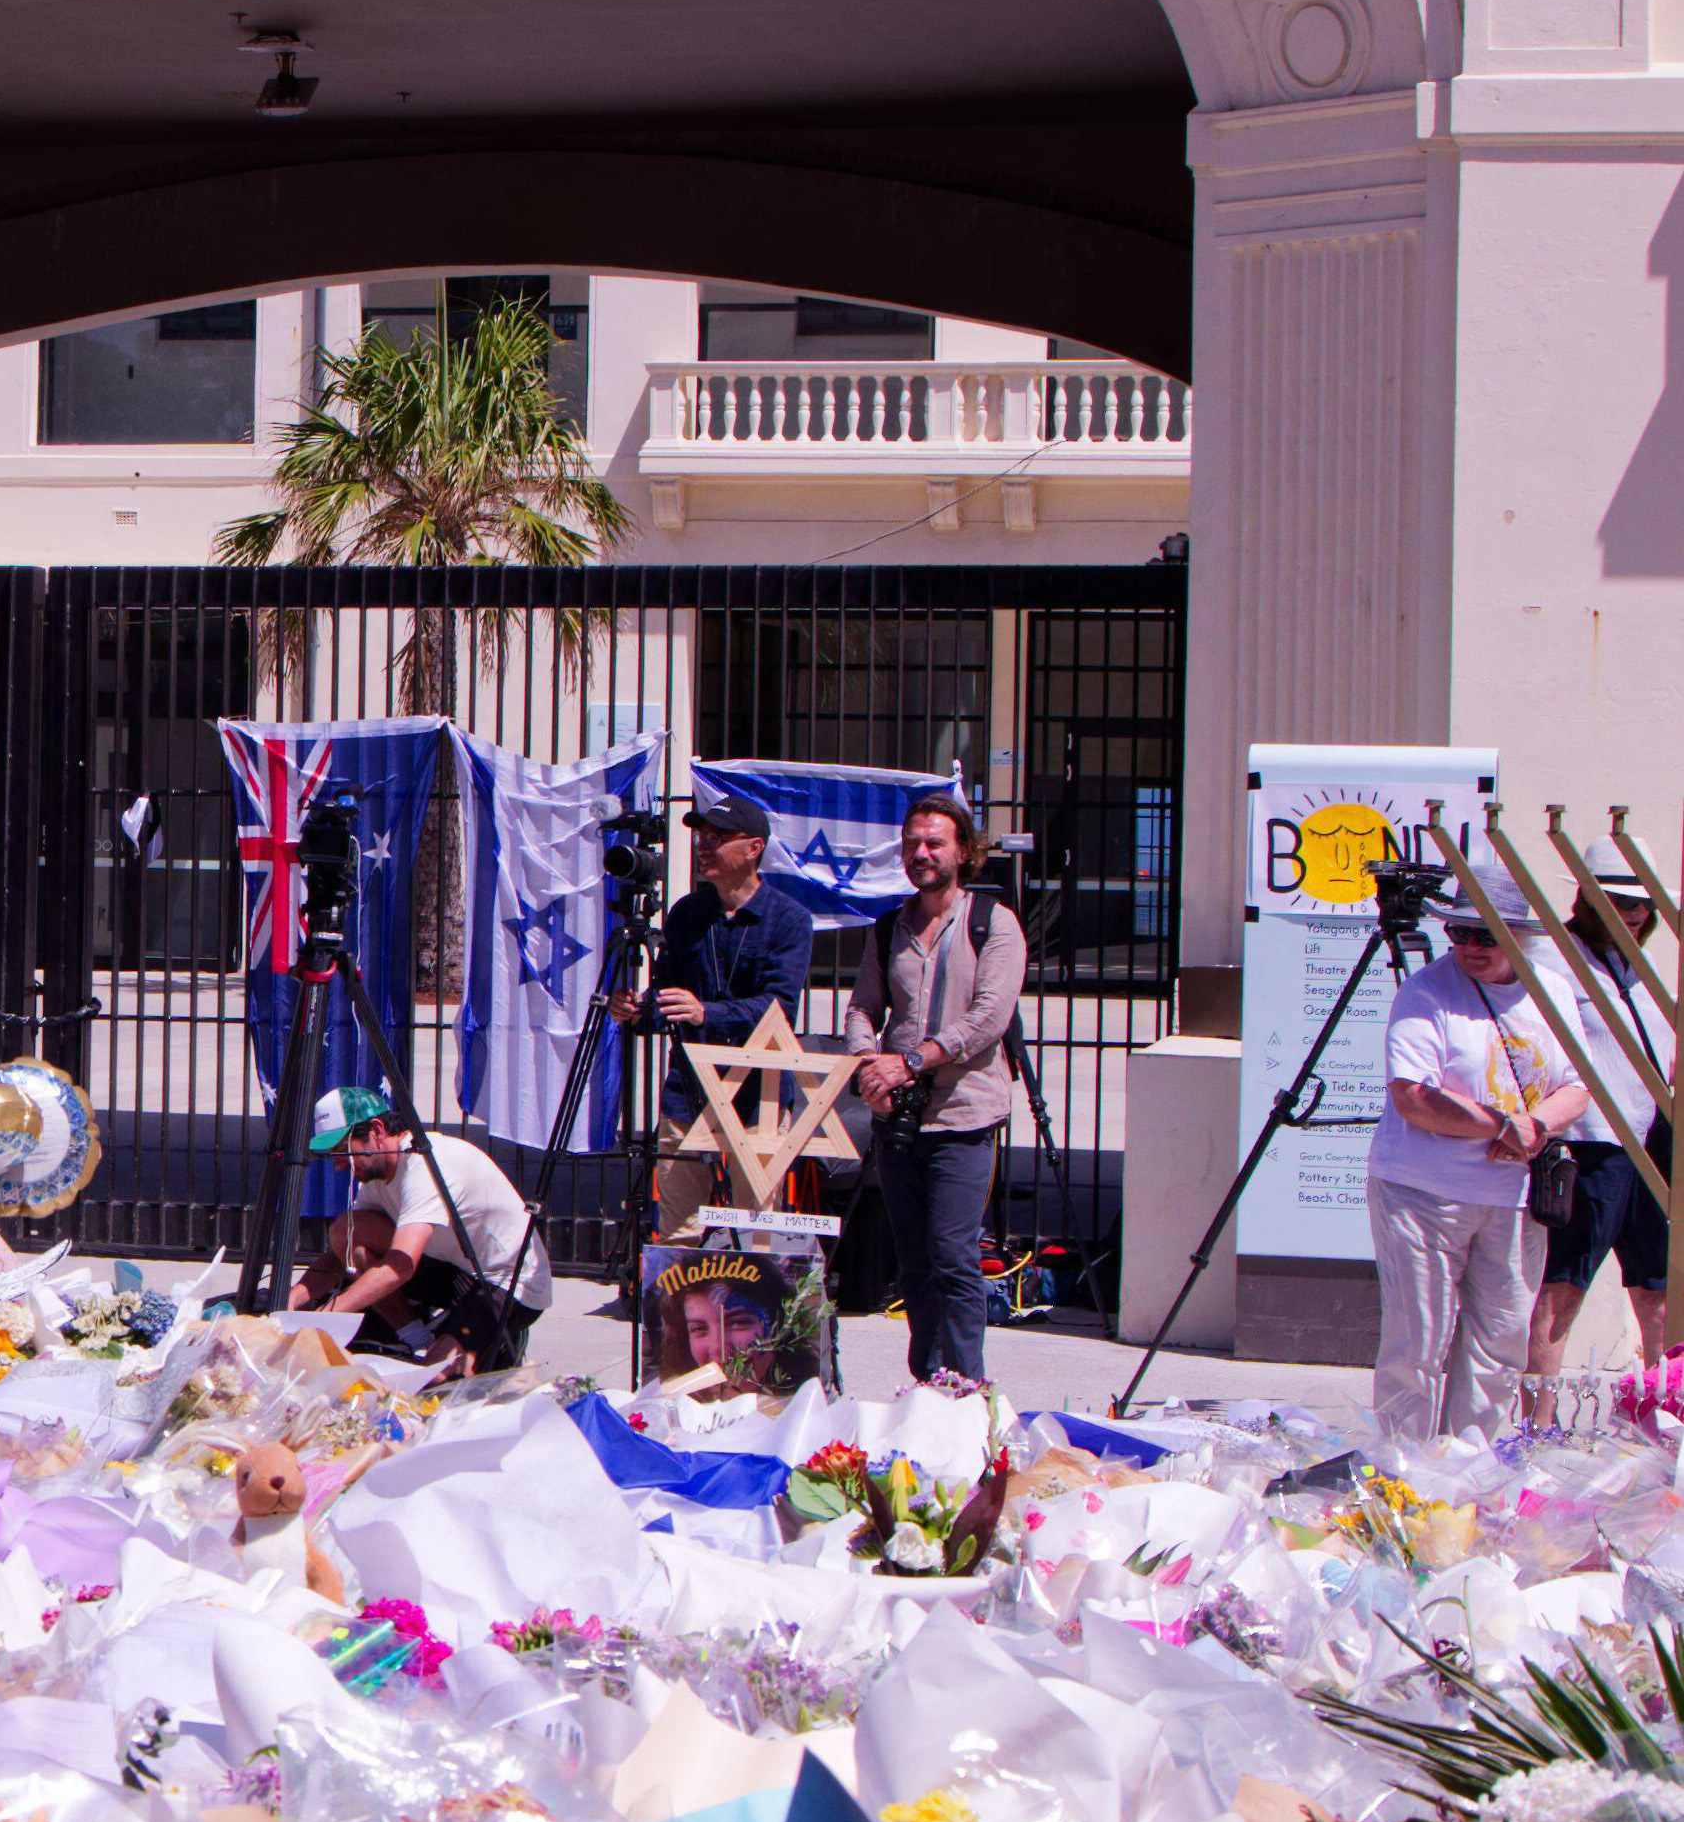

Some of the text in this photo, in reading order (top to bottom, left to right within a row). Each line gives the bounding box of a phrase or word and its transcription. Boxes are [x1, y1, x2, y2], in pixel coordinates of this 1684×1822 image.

[1304, 943, 1321, 955] Lift
[1305, 963, 1347, 976] Theatre
[1354, 987, 1382, 998] oom
[1304, 1004, 1378, 1017] Ocea Room
[1331, 1081, 1355, 1093] Tide
[1301, 1100, 1363, 1114] Cmmunity
[1298, 1171, 1341, 1186] Pottery
[1298, 1191, 1332, 1203] Beach
[704, 1210, 738, 1224] JEWISH
[785, 1216, 831, 1230] MATTER
[656, 1254, 761, 1296] Matilda
